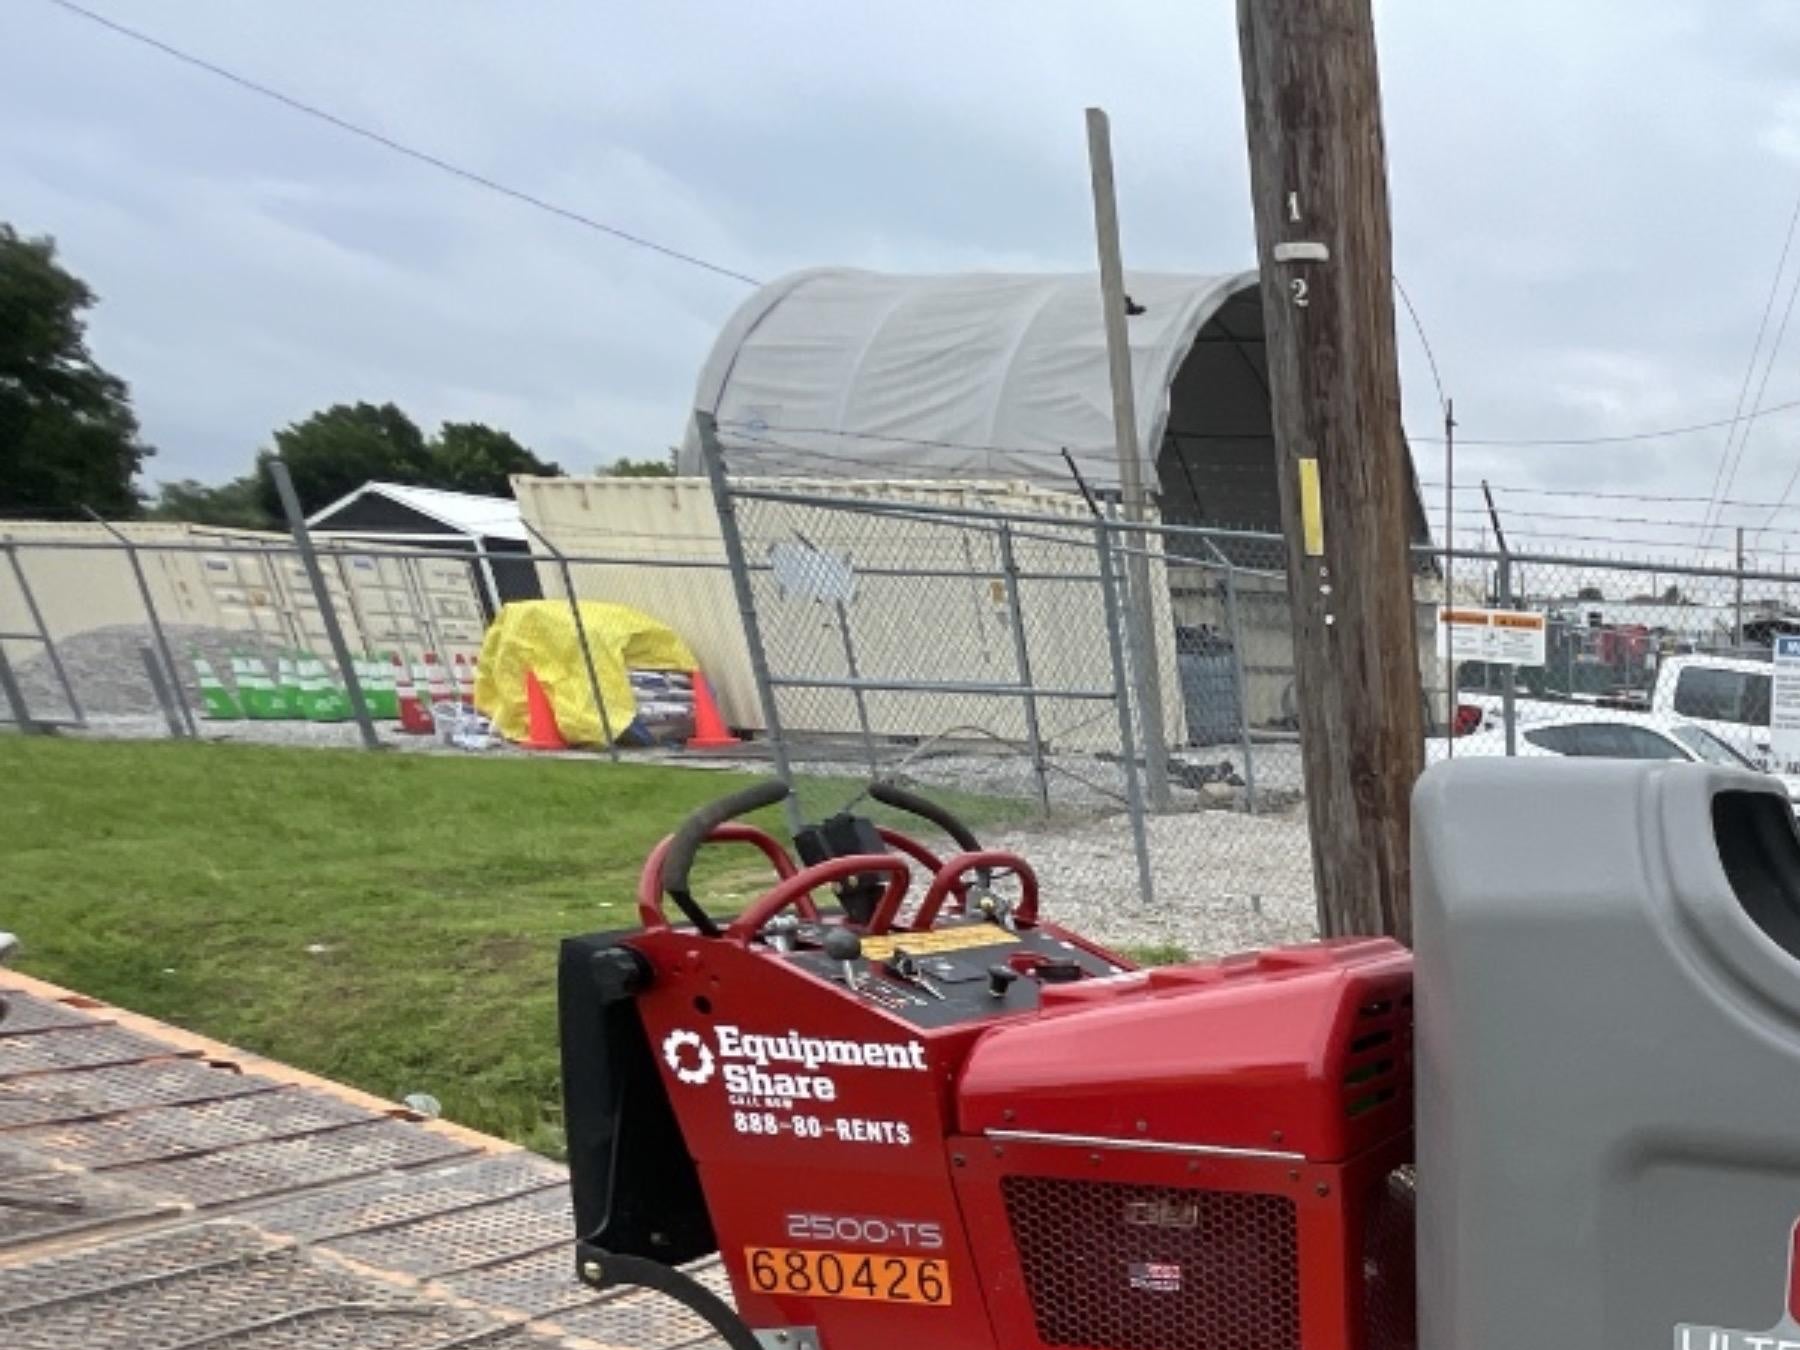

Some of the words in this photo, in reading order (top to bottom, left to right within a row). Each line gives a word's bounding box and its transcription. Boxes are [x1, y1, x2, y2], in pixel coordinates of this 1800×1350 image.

[1289, 278, 1309, 306] 2
[713, 1025, 928, 1071] Equipment
[722, 1063, 837, 1101] Share
[733, 1112, 912, 1145] 888-80-RENTS
[752, 1249, 944, 1303] 680426
